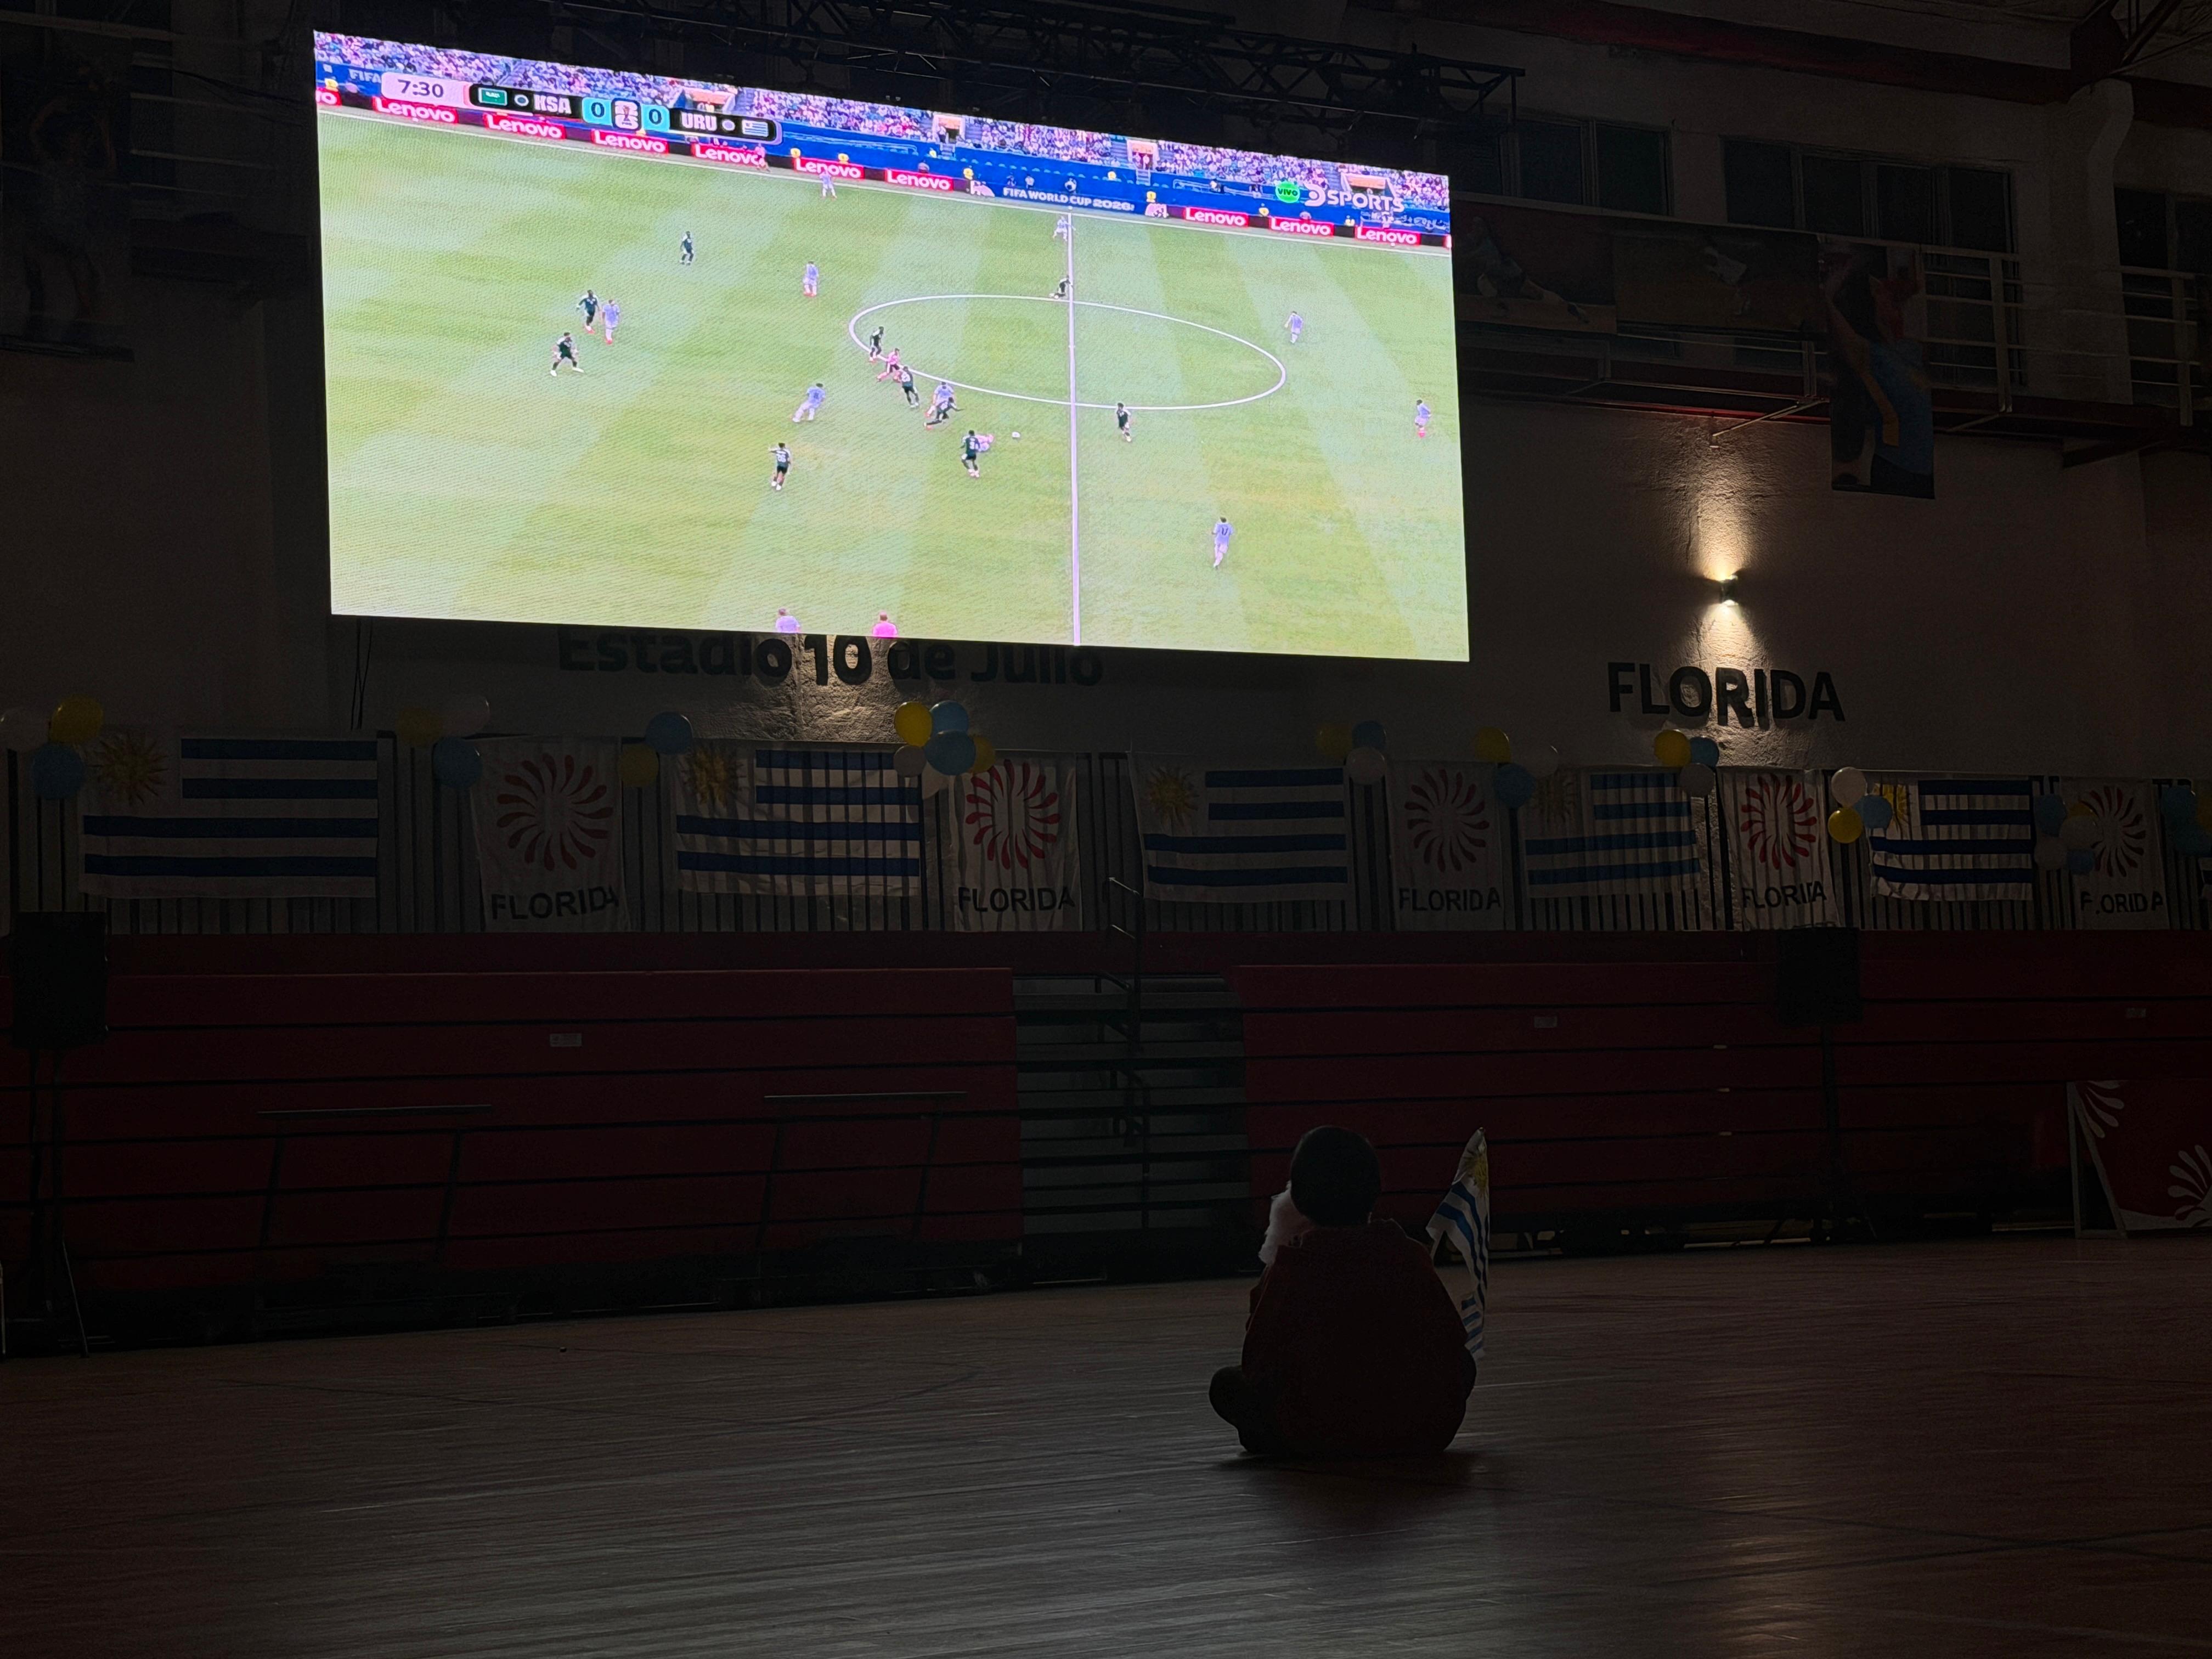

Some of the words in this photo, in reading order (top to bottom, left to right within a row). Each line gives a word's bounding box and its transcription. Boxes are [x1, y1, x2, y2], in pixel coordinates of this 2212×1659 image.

[348, 69, 381, 83] FIFA
[397, 79, 443, 98] 7:30
[376, 97, 455, 122] Lenovo
[534, 94, 572, 114] KSA
[591, 102, 605, 118] 0
[487, 114, 563, 138] Lenovo
[648, 109, 662, 125] 0
[681, 112, 718, 132] URU
[594, 129, 666, 153] Lenovo
[795, 159, 861, 179] Lenovo
[887, 171, 951, 190] Lenovo
[1003, 188, 1028, 198] FIFA
[1028, 190, 1068, 204] WORLD
[1069, 195, 1092, 206] CUP
[1186, 207, 1246, 226] Lenovo
[1271, 217, 1331, 236] Lenovo
[1357, 227, 1417, 244] Lenovo
[557, 625, 792, 677] Estadio
[804, 635, 872, 686] 10
[888, 639, 956, 680] de
[970, 644, 1103, 686] Julio
[1608, 662, 1846, 723] FLORIDA
[958, 886, 1076, 912] FLORIDA
[1399, 887, 1501, 911] FLORIDA
[2080, 890, 2164, 914] FORIDA
